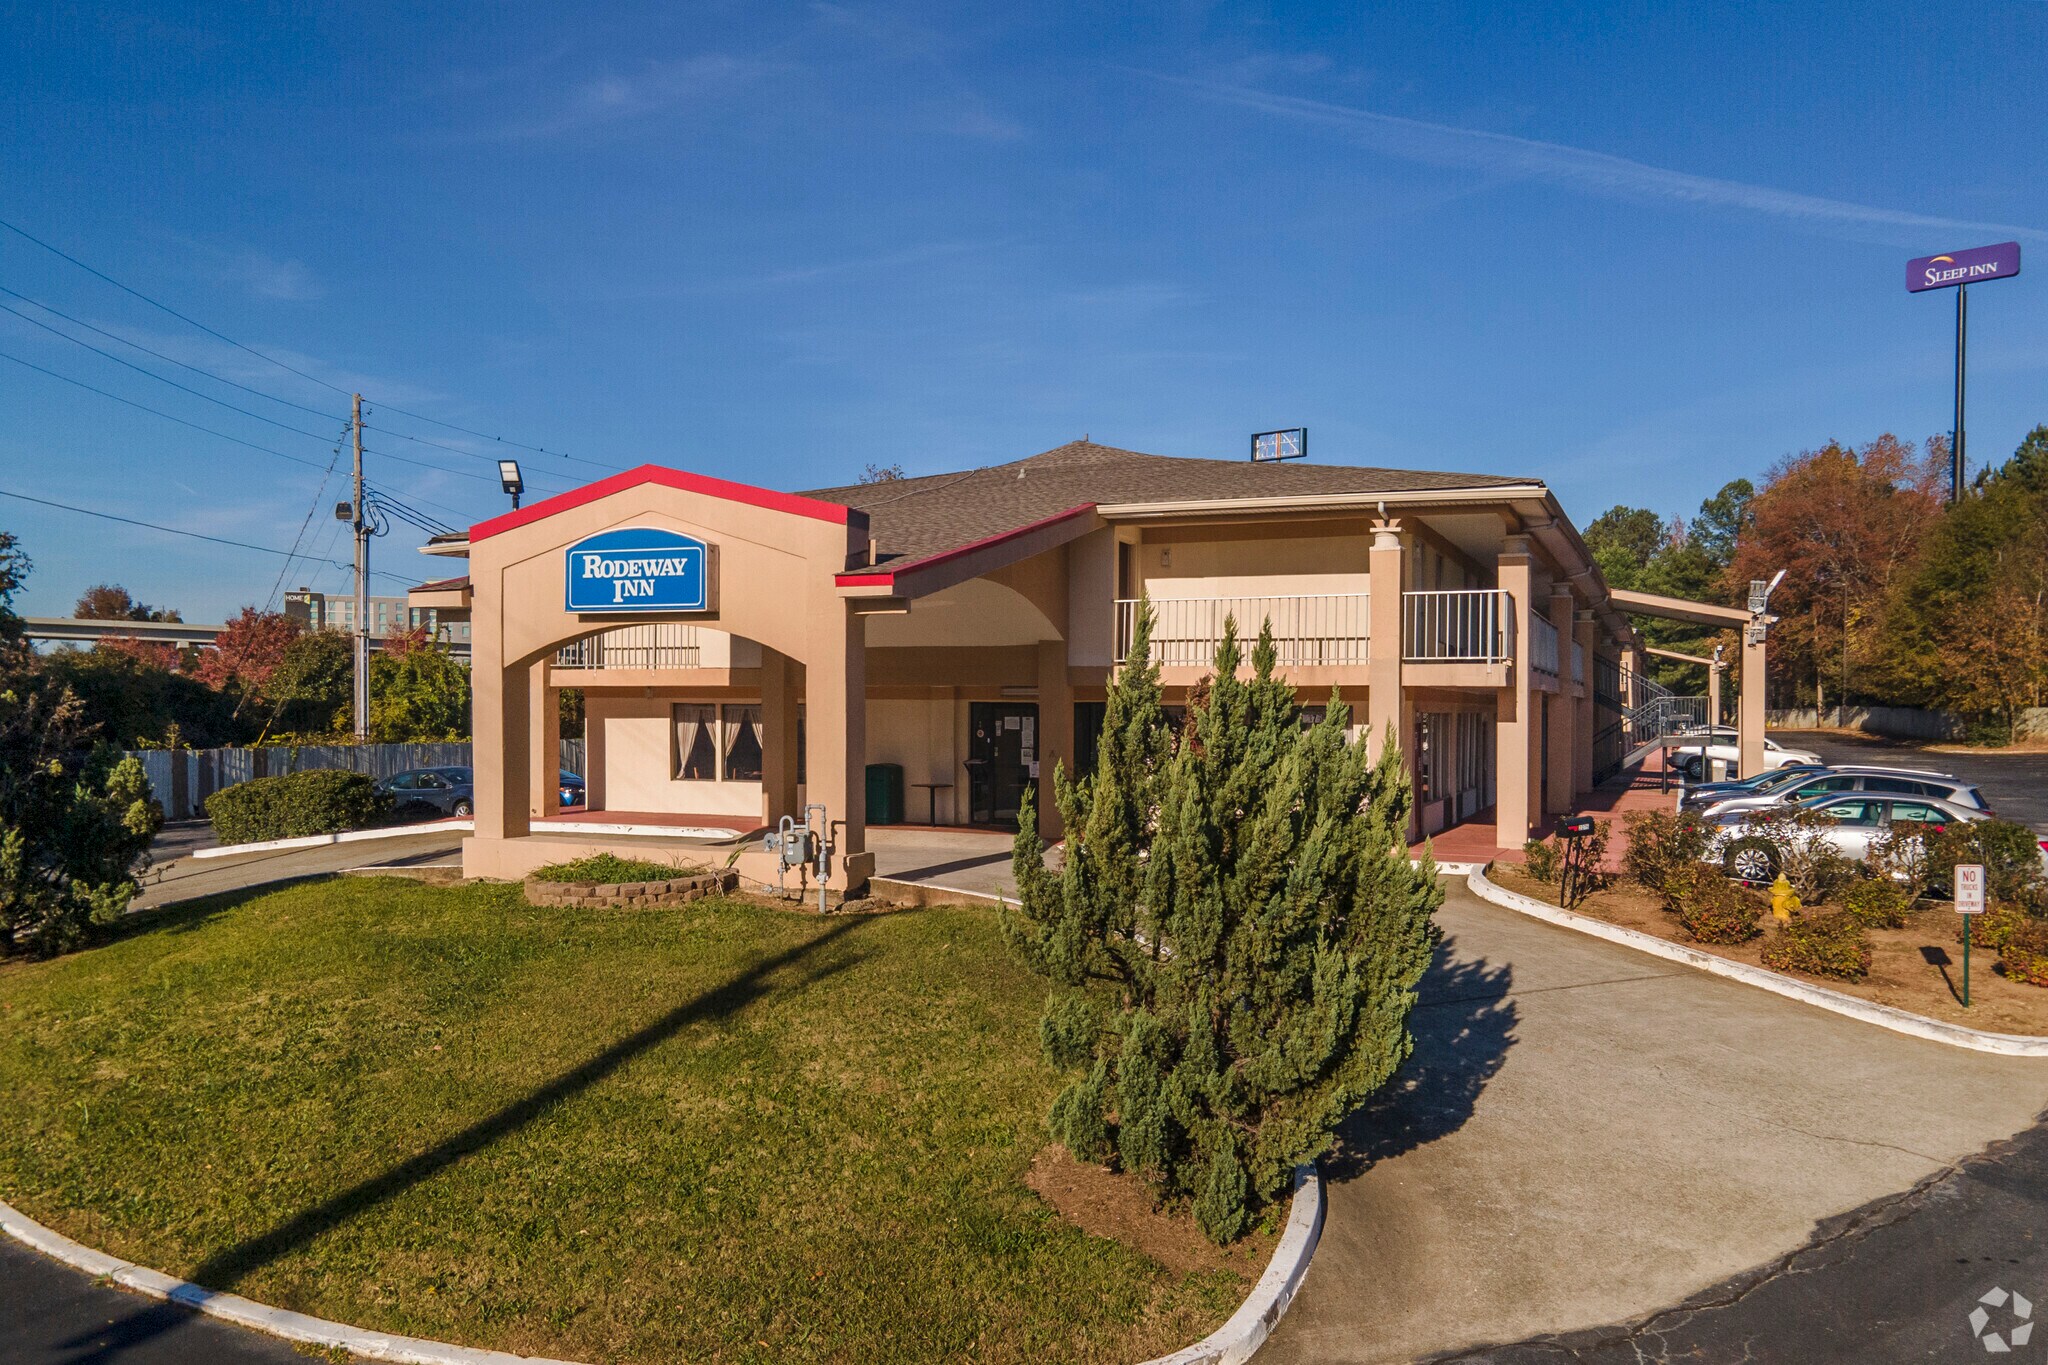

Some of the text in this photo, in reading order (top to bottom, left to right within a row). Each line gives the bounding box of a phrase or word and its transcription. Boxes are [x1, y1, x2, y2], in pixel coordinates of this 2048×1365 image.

[1925, 262, 1998, 286] SLEEP INN
[582, 555, 688, 578] RODEWAY
[613, 579, 655, 603] INN
[1962, 870, 1976, 882] NO
